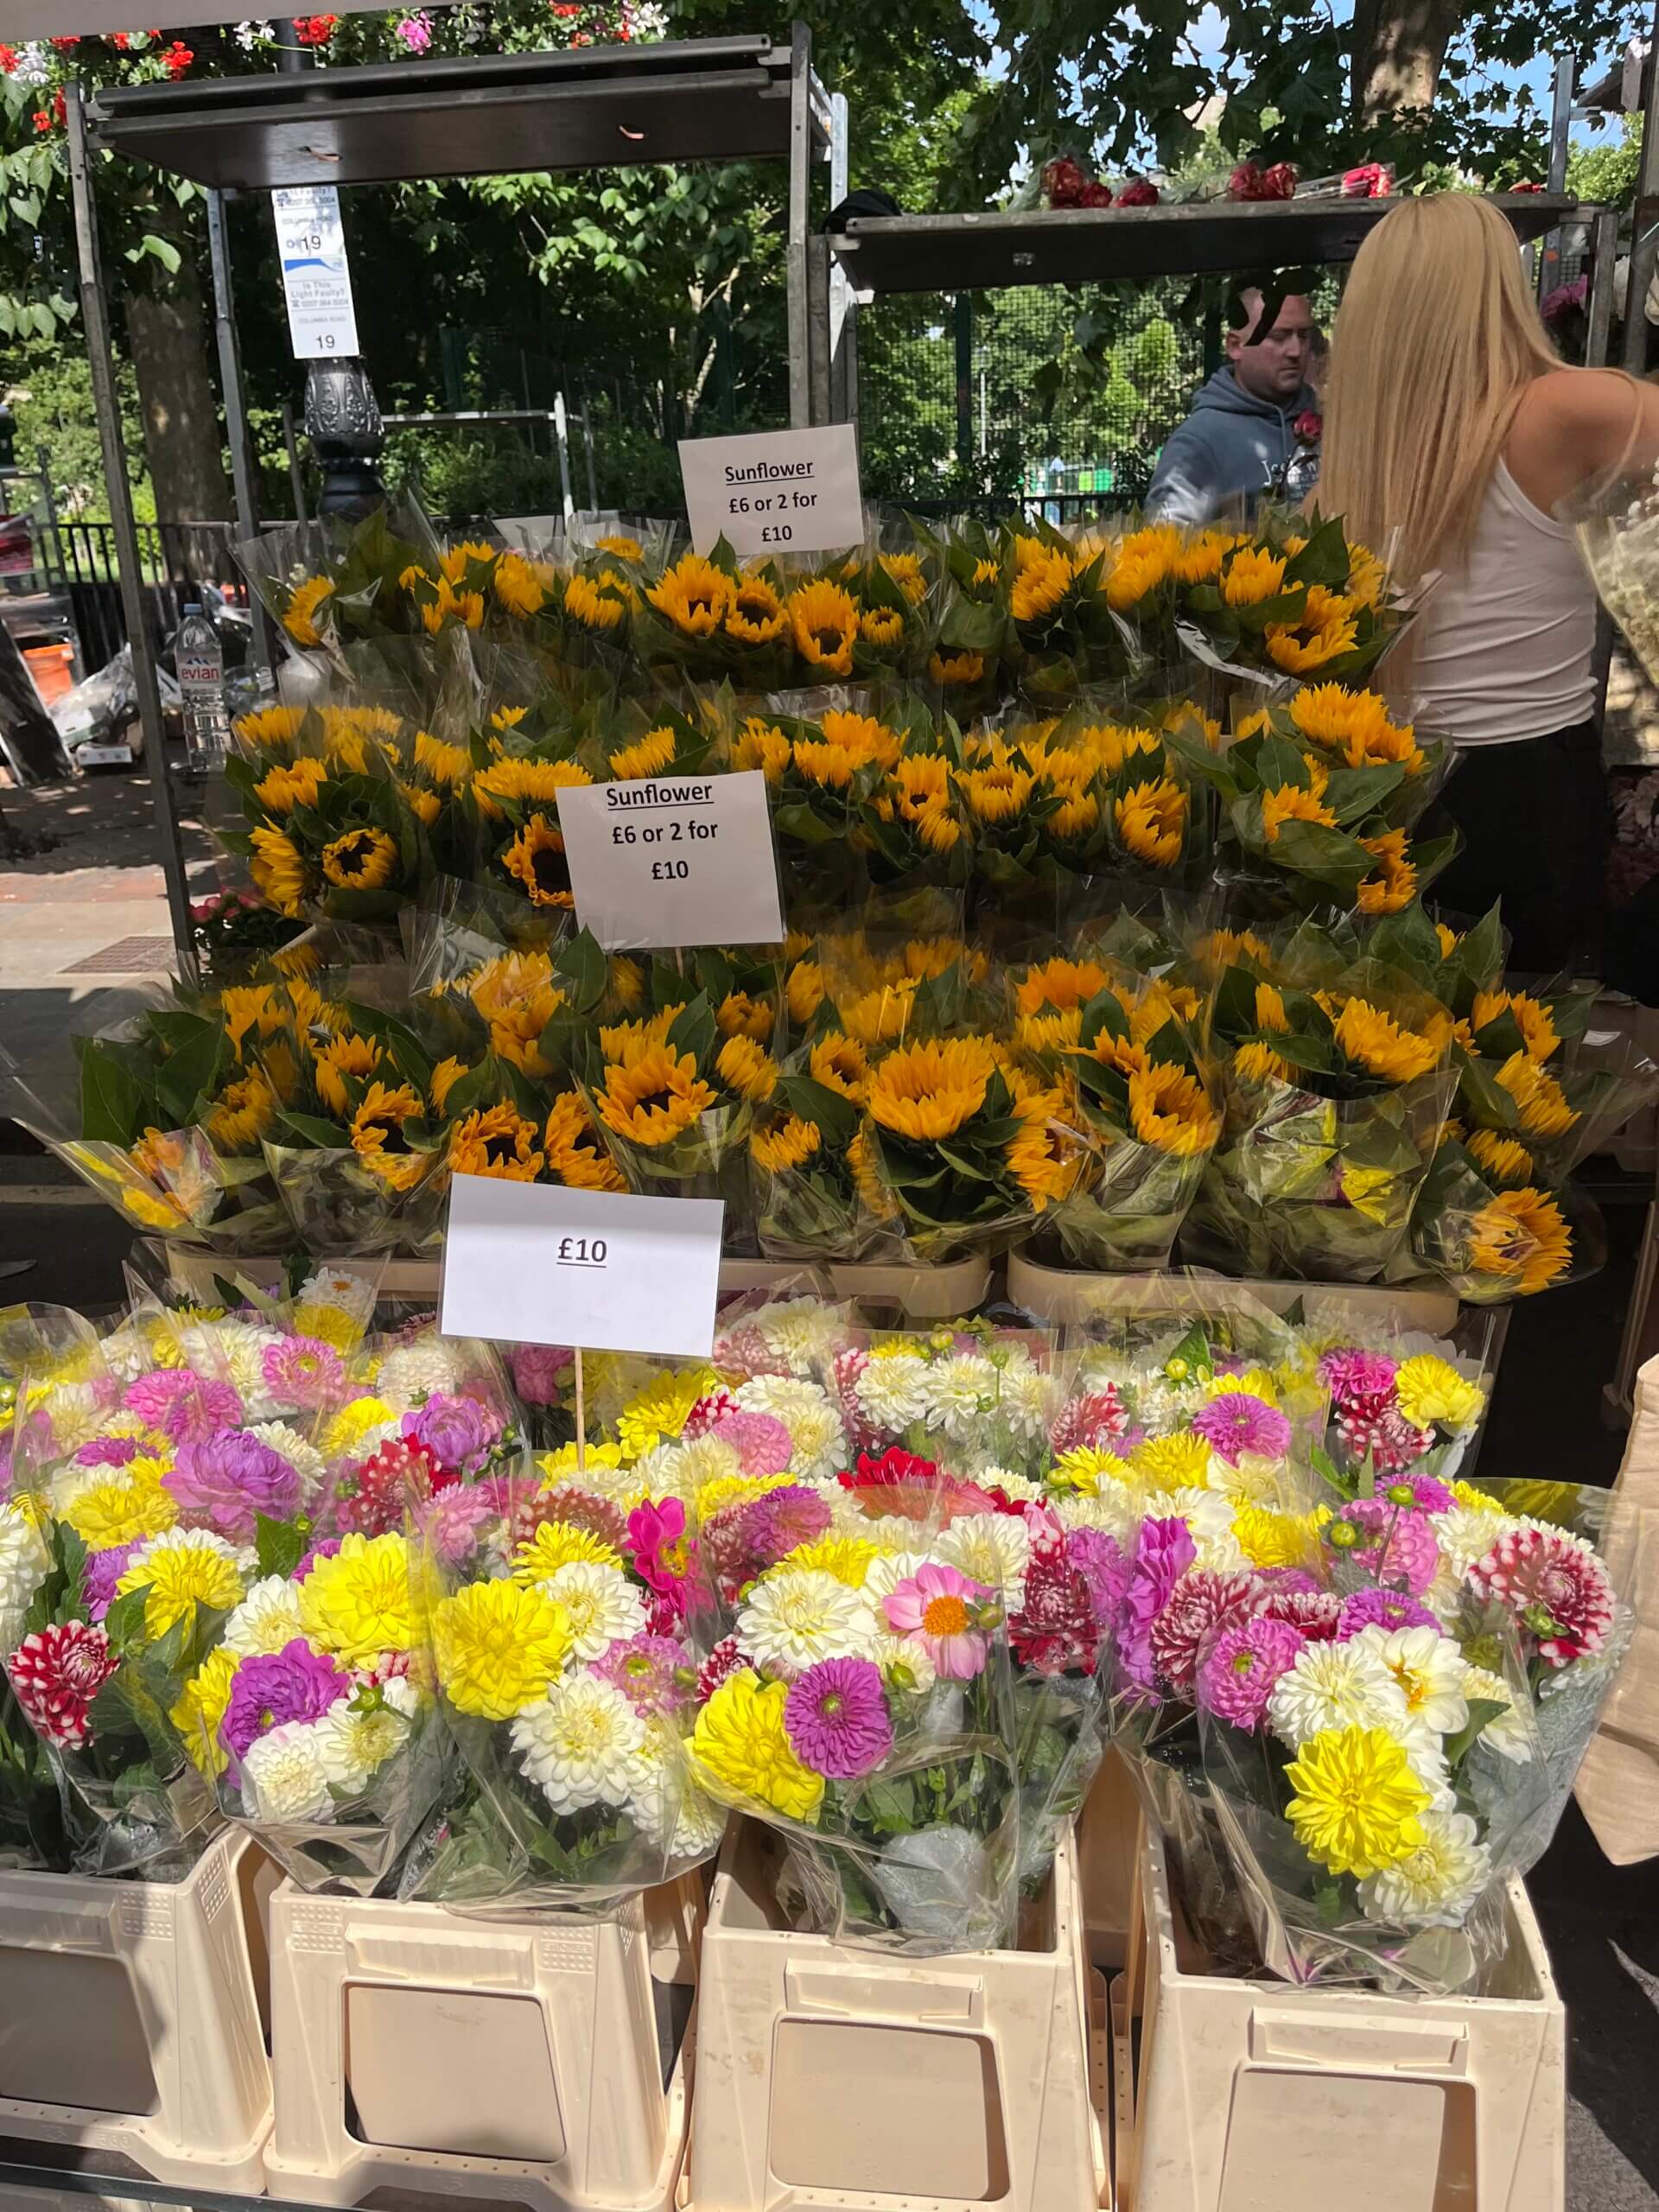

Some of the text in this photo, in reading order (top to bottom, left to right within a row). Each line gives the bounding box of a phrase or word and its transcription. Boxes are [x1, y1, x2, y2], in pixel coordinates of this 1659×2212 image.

[302, 235, 321, 250] 19
[315, 334, 335, 350] 19
[725, 462, 814, 484] Sunflower
[729, 492, 817, 513] £6 or 2 for
[761, 525, 792, 542] £10
[181, 666, 220, 679] evian
[607, 784, 713, 807] Sunflower
[612, 820, 718, 844] £6 or 2 for
[652, 861, 689, 880] £10
[557, 1237, 607, 1262] £10
